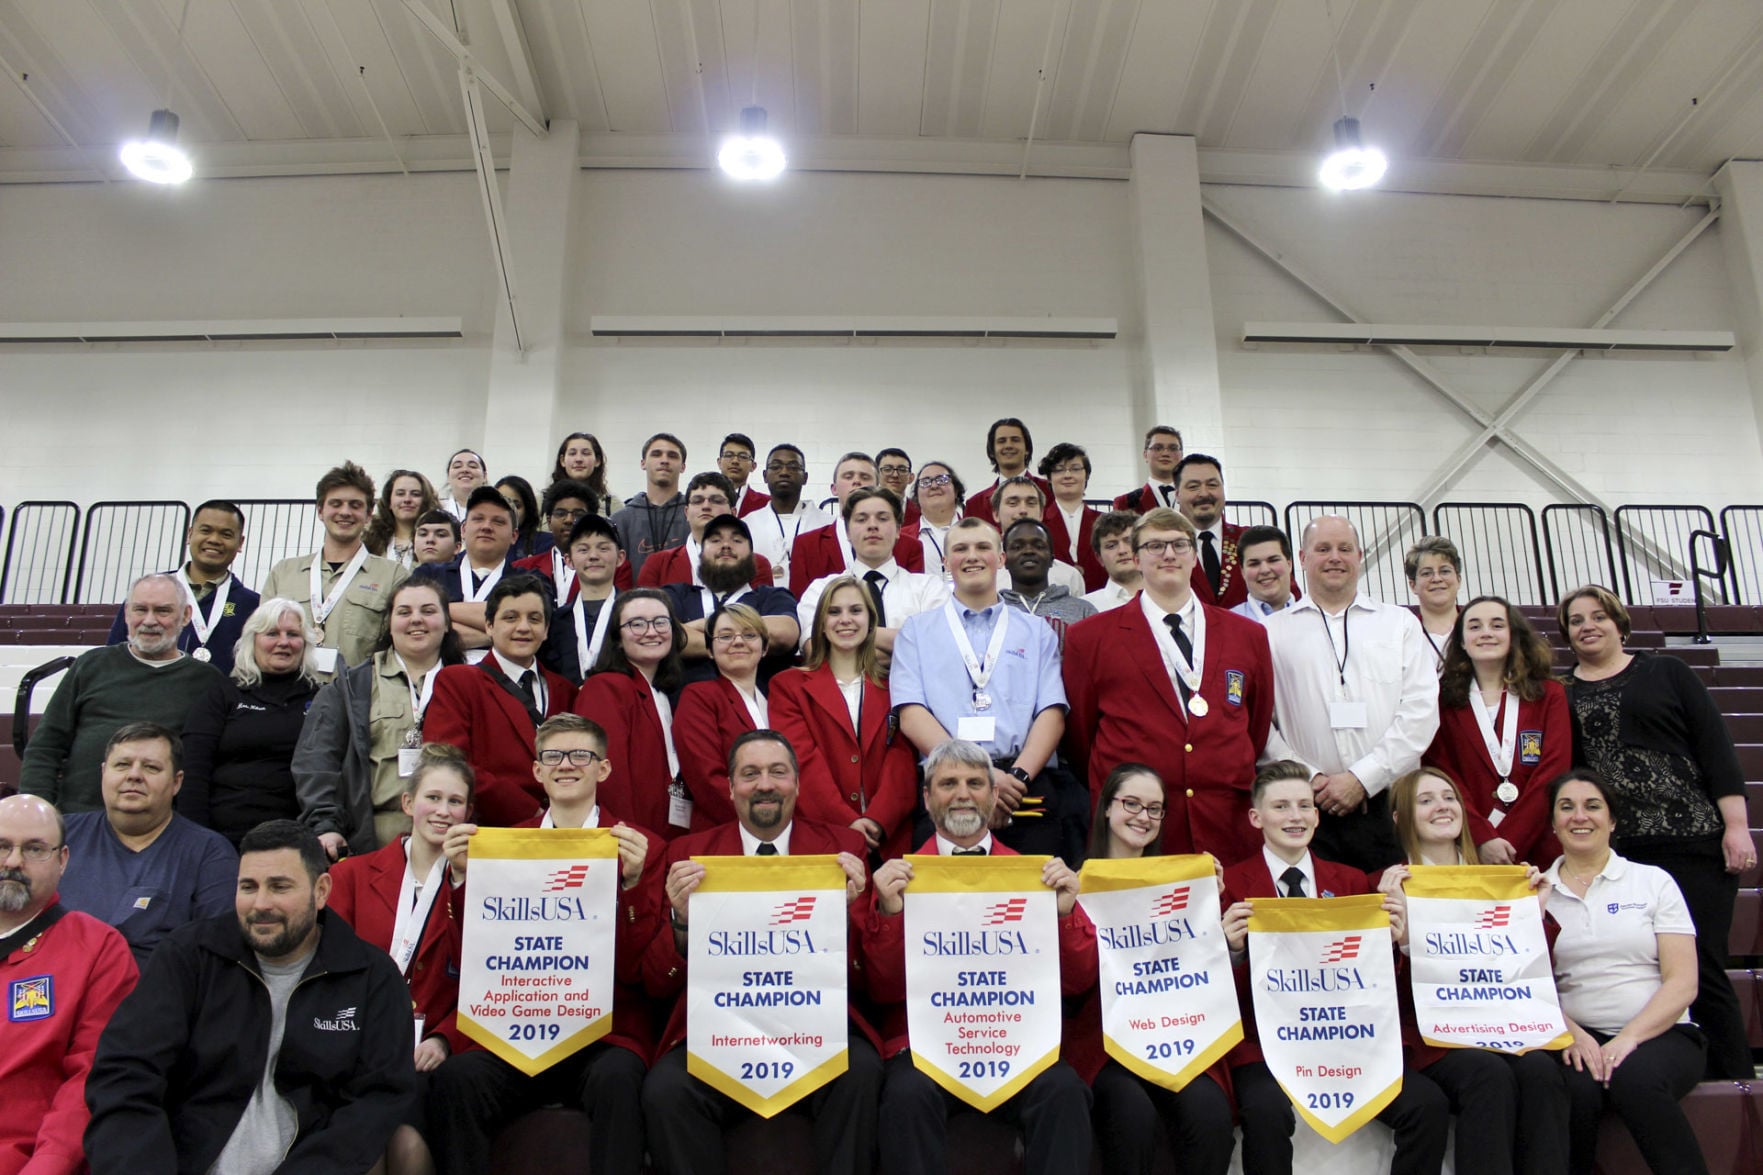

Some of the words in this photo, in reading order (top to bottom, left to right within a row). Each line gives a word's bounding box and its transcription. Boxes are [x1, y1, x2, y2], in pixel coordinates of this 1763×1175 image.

[483, 897, 585, 921] SkillsUSA
[708, 930, 815, 956] SkillsUSA
[1099, 919, 1197, 949] SkillsUSA
[514, 936, 563, 952] STATE
[923, 931, 1028, 956] SkillsUSA
[1427, 934, 1519, 955] SkillsUSA
[485, 955, 590, 971] CHAMPION
[1133, 956, 1181, 977] STATE
[501, 976, 573, 987] Interactive
[742, 970, 793, 988] STATE
[957, 970, 1007, 987] STATE
[1115, 970, 1210, 996] CHAMPION
[1267, 968, 1365, 993] SkillsUSA
[1459, 968, 1503, 984] STATE
[483, 989, 559, 1004] Application
[564, 990, 589, 1002] and
[713, 990, 822, 1008] CHAMPION
[930, 990, 1035, 1008] CHAMPION
[1436, 985, 1532, 1001] CHAMPION
[470, 1004, 507, 1017] Video
[511, 1004, 552, 1018] Game
[557, 1004, 601, 1019] Design
[944, 1012, 1022, 1024] Automotive
[1299, 1006, 1346, 1023] STATE
[1129, 1018, 1157, 1031] Web
[1161, 1012, 1206, 1028] Design
[1433, 1023, 1505, 1035] Advertising
[1508, 1021, 1554, 1033] Design
[509, 1023, 560, 1041] 2019
[712, 1034, 823, 1048] Internetworking
[958, 1026, 1008, 1039] Service
[1276, 1023, 1375, 1041] CHAMPION
[945, 1041, 1020, 1057] Technology
[1146, 1039, 1196, 1060] 2019
[741, 1061, 795, 1080] 2019
[959, 1060, 1011, 1079] 2019
[1295, 1065, 1313, 1076] Pin
[1317, 1065, 1361, 1079] Design
[1307, 1091, 1355, 1110] 2019
